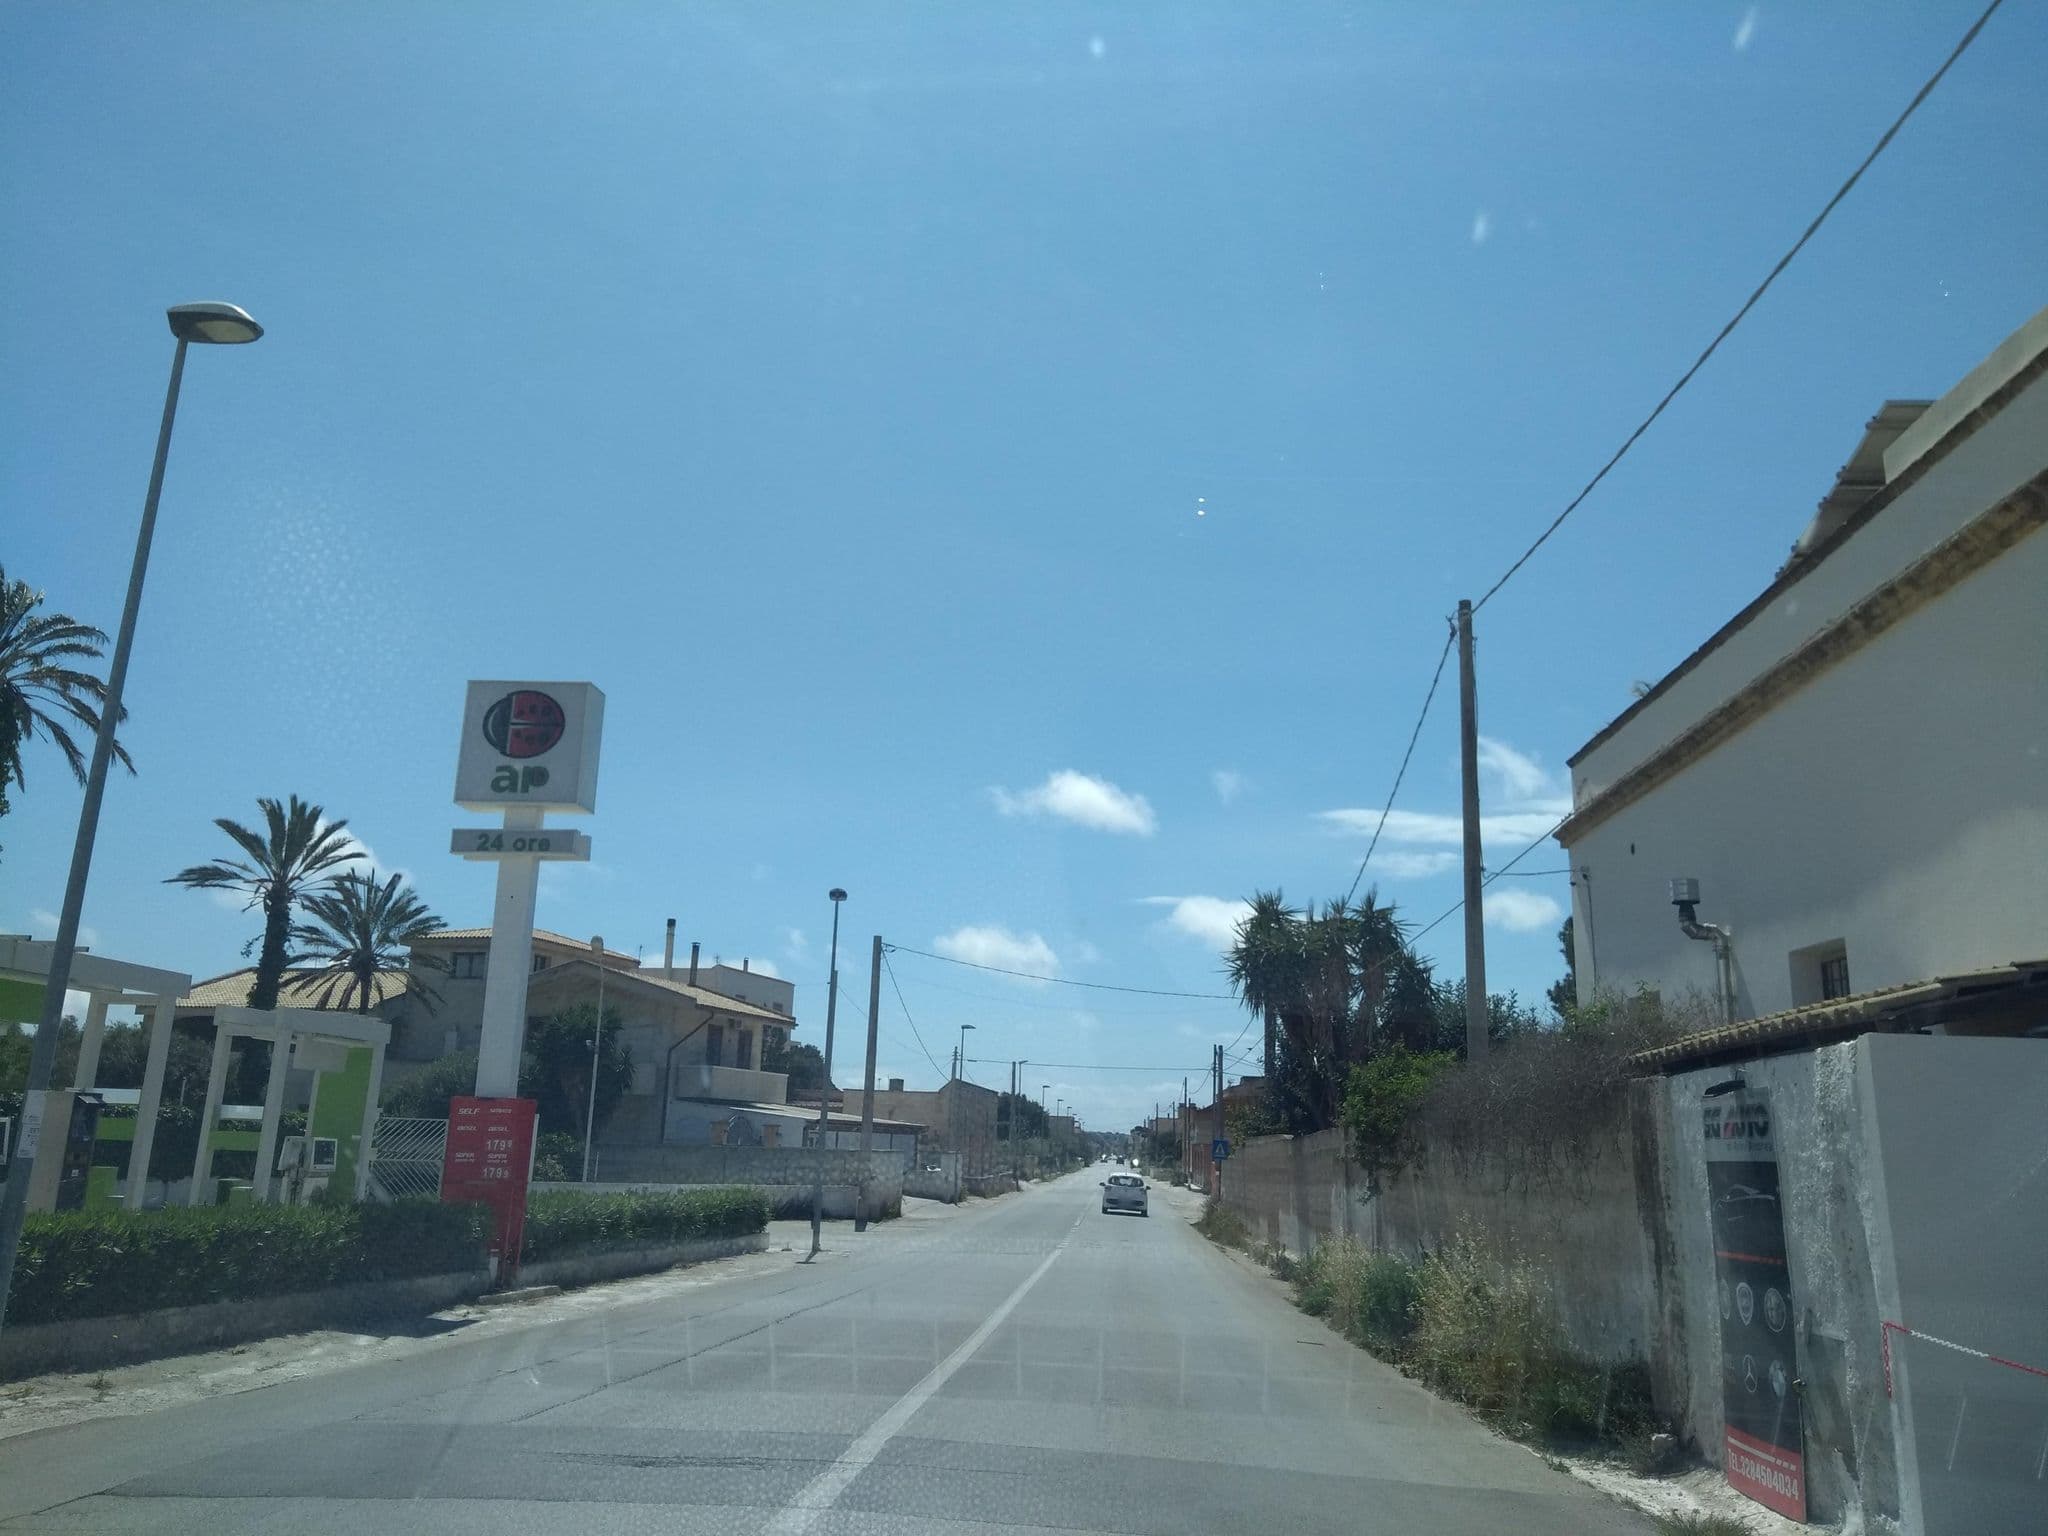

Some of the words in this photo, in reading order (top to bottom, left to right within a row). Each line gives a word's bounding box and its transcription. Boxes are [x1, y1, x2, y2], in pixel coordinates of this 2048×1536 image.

[477, 833, 504, 852] 24
[512, 836, 551, 852] ore
[457, 1107, 481, 1115] SELF
